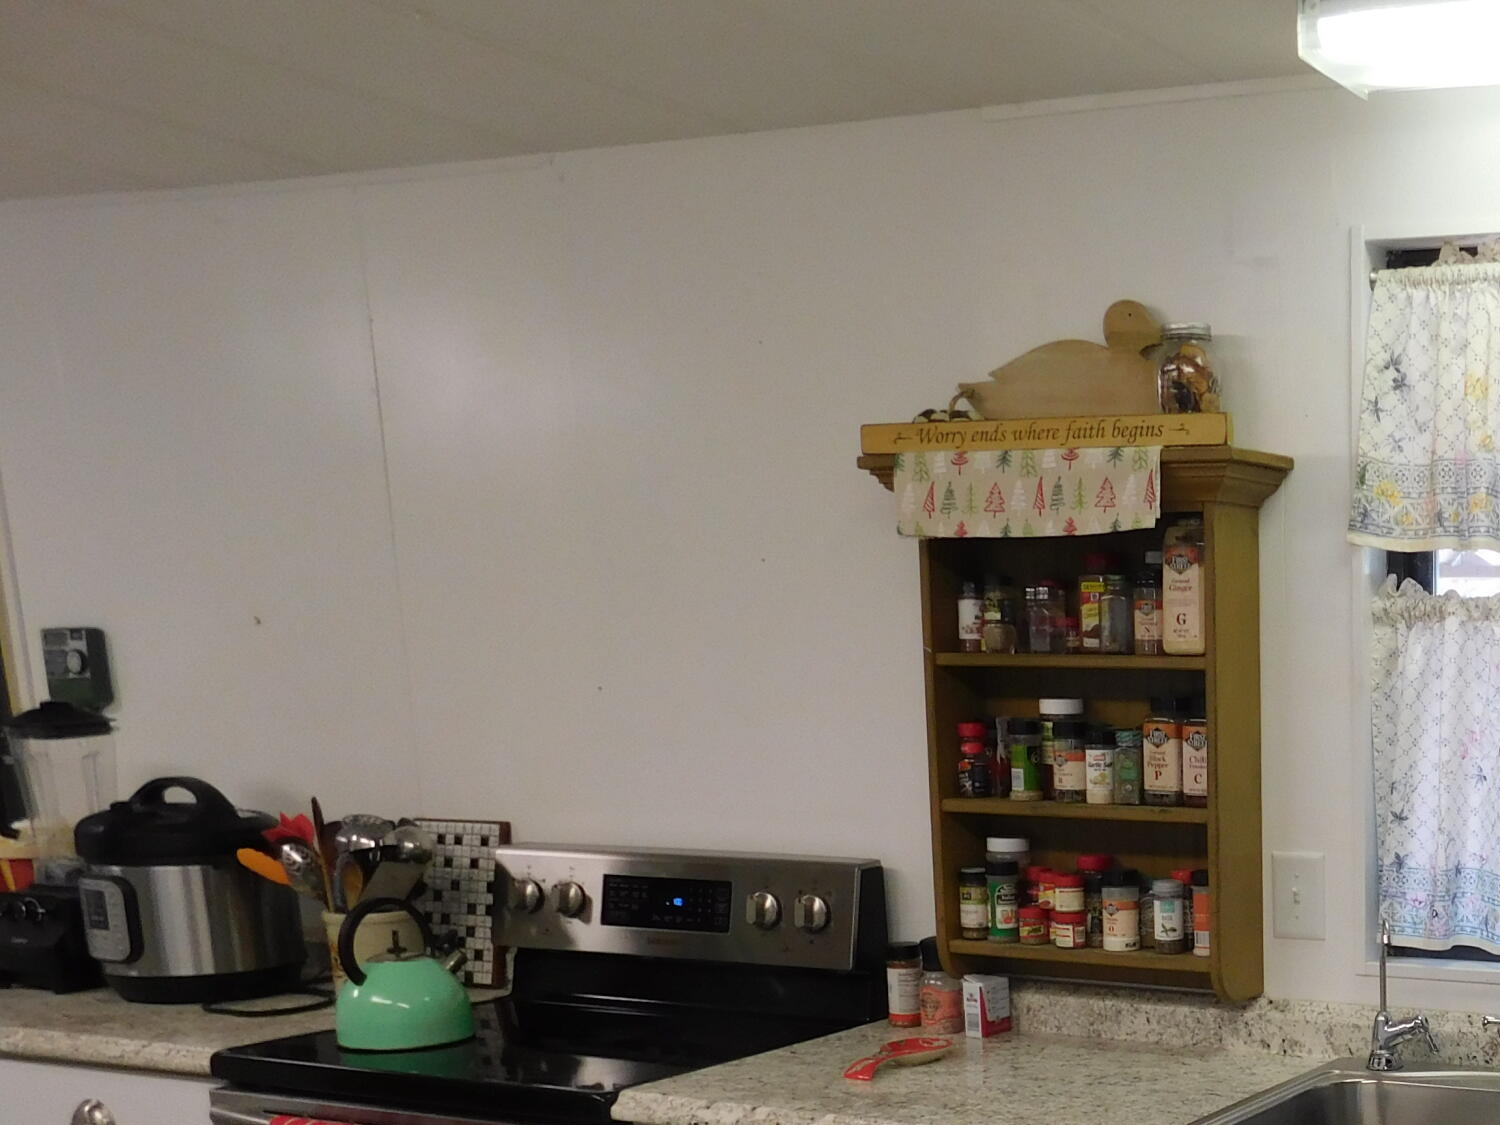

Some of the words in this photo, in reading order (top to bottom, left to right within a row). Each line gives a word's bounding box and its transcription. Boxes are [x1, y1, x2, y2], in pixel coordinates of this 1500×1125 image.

[917, 425, 966, 448] Worry
[971, 425, 1008, 442] ends
[1011, 422, 1059, 441] where
[1060, 419, 1106, 446] faith
[1111, 418, 1164, 444] begins
[1176, 612, 1187, 625] G
[1154, 770, 1162, 780] P
[1193, 773, 1202, 784] C
